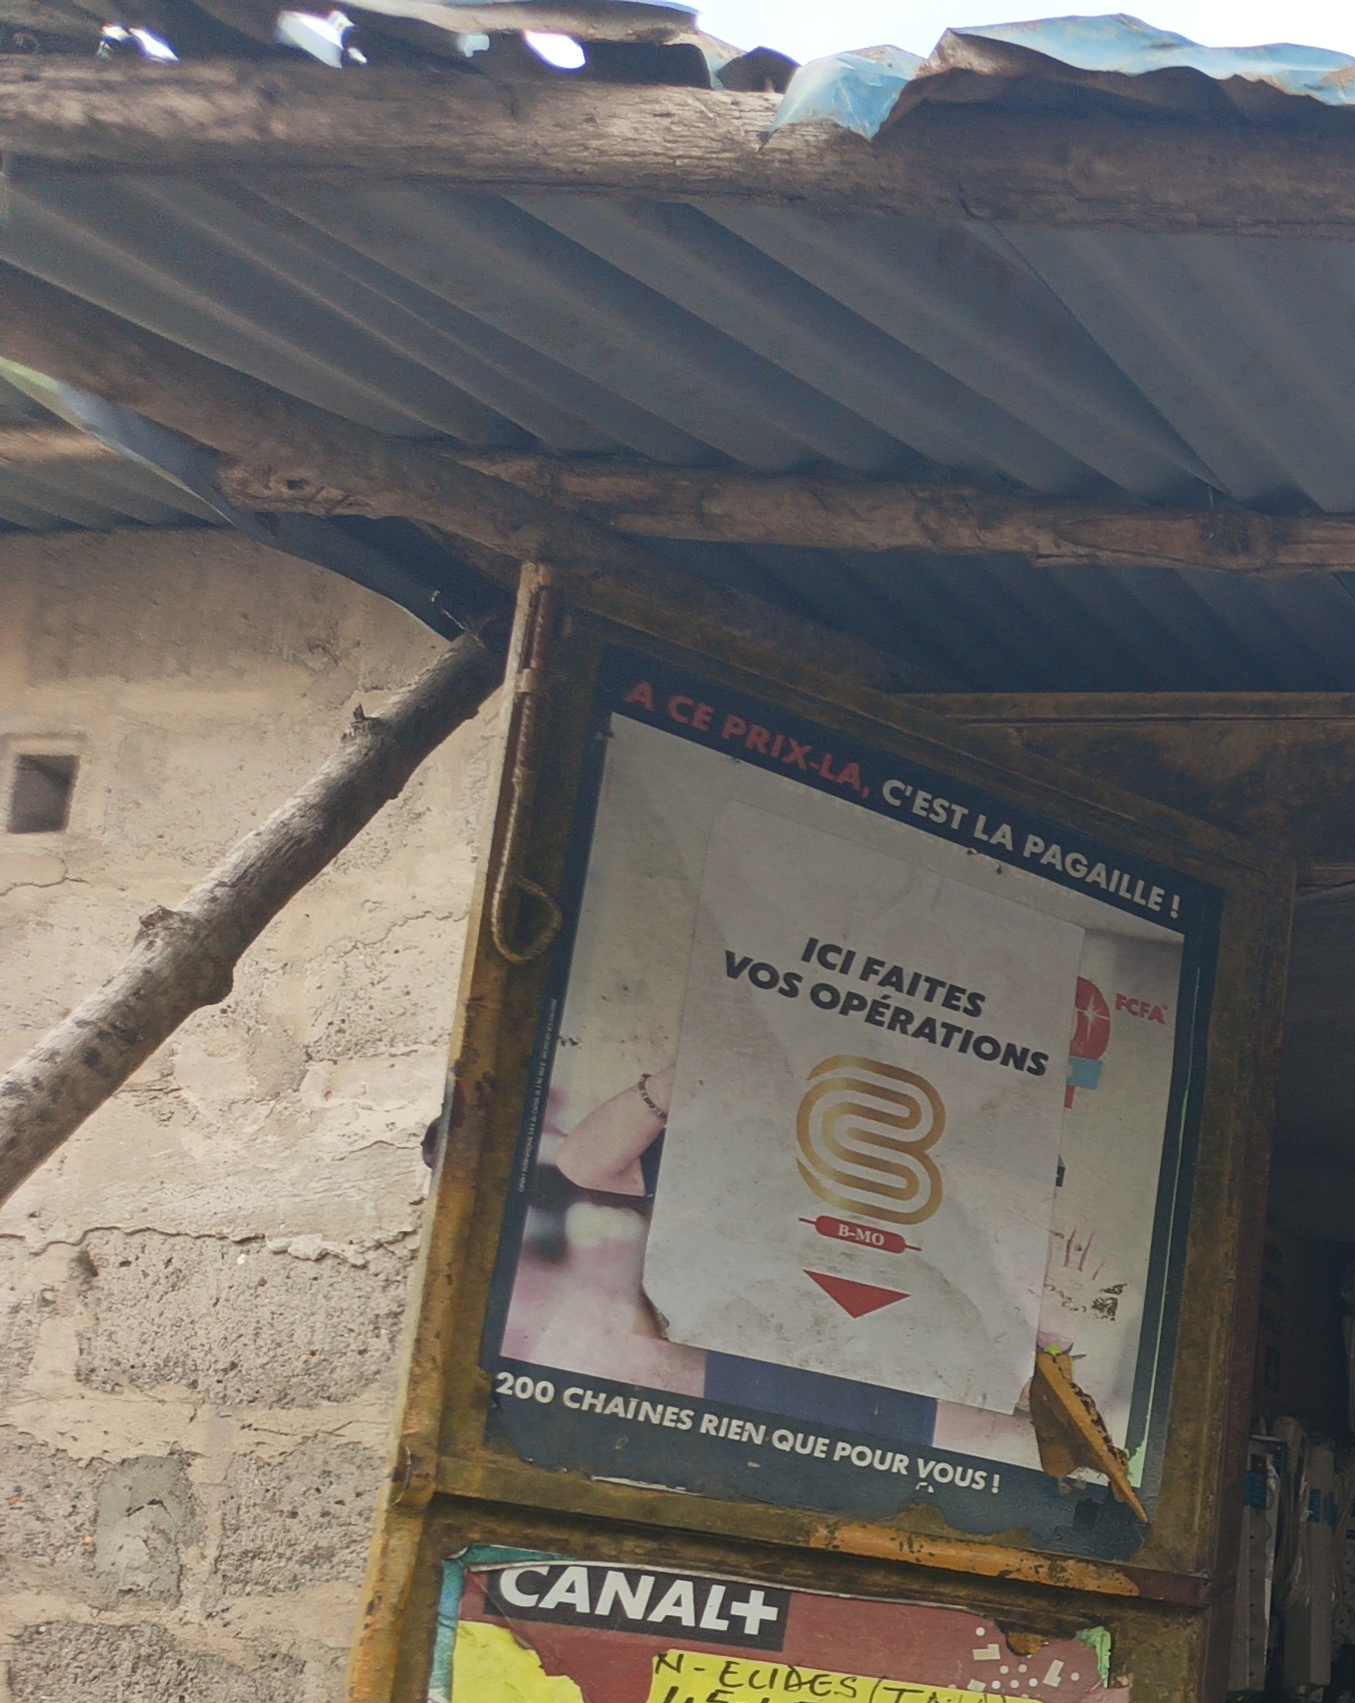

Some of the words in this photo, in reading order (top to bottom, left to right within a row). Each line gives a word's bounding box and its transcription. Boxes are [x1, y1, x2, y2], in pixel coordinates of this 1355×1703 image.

[624, 680, 654, 712] A
[667, 695, 715, 731] CE
[721, 714, 870, 799] PRIX-LA,
[882, 780, 968, 830] C'EST
[974, 815, 1013, 850] LA
[1023, 834, 1166, 911] PAGAILLE
[1170, 895, 1181, 918] !
[724, 950, 803, 998] VOS
[810, 982, 1048, 1076] OPÉRATIONS
[801, 937, 856, 975] ICI
[859, 956, 986, 1017] FAITES
[838, 1224, 885, 1246] B-MO
[495, 1371, 555, 1404] 200
[700, 1413, 767, 1445] RIEN
[771, 1428, 830, 1459] QUE
[833, 1441, 910, 1475] POUR
[916, 1458, 988, 1491] VOUS
[991, 1473, 1000, 1494] !
[500, 1566, 778, 1635] CANAL+
